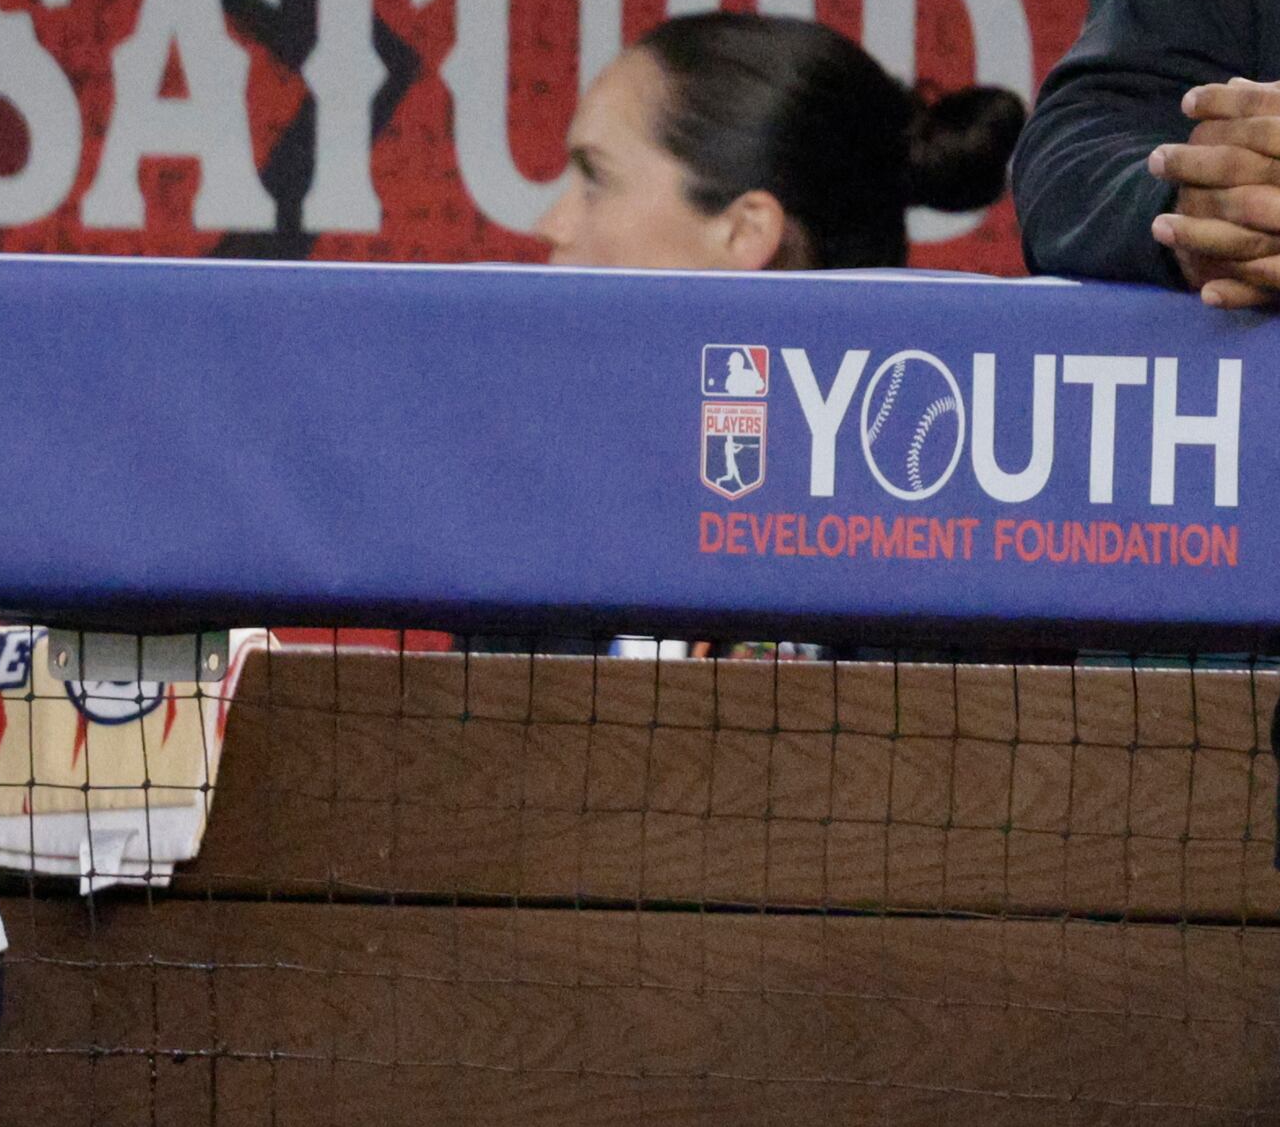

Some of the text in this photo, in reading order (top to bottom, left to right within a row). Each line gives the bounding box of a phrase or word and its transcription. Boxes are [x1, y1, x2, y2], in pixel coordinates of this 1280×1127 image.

[706, 415, 762, 435] PLAYERS
[780, 347, 1243, 508] YOUTH
[698, 511, 1240, 566] DEVELOPMENT FOUNDATION
